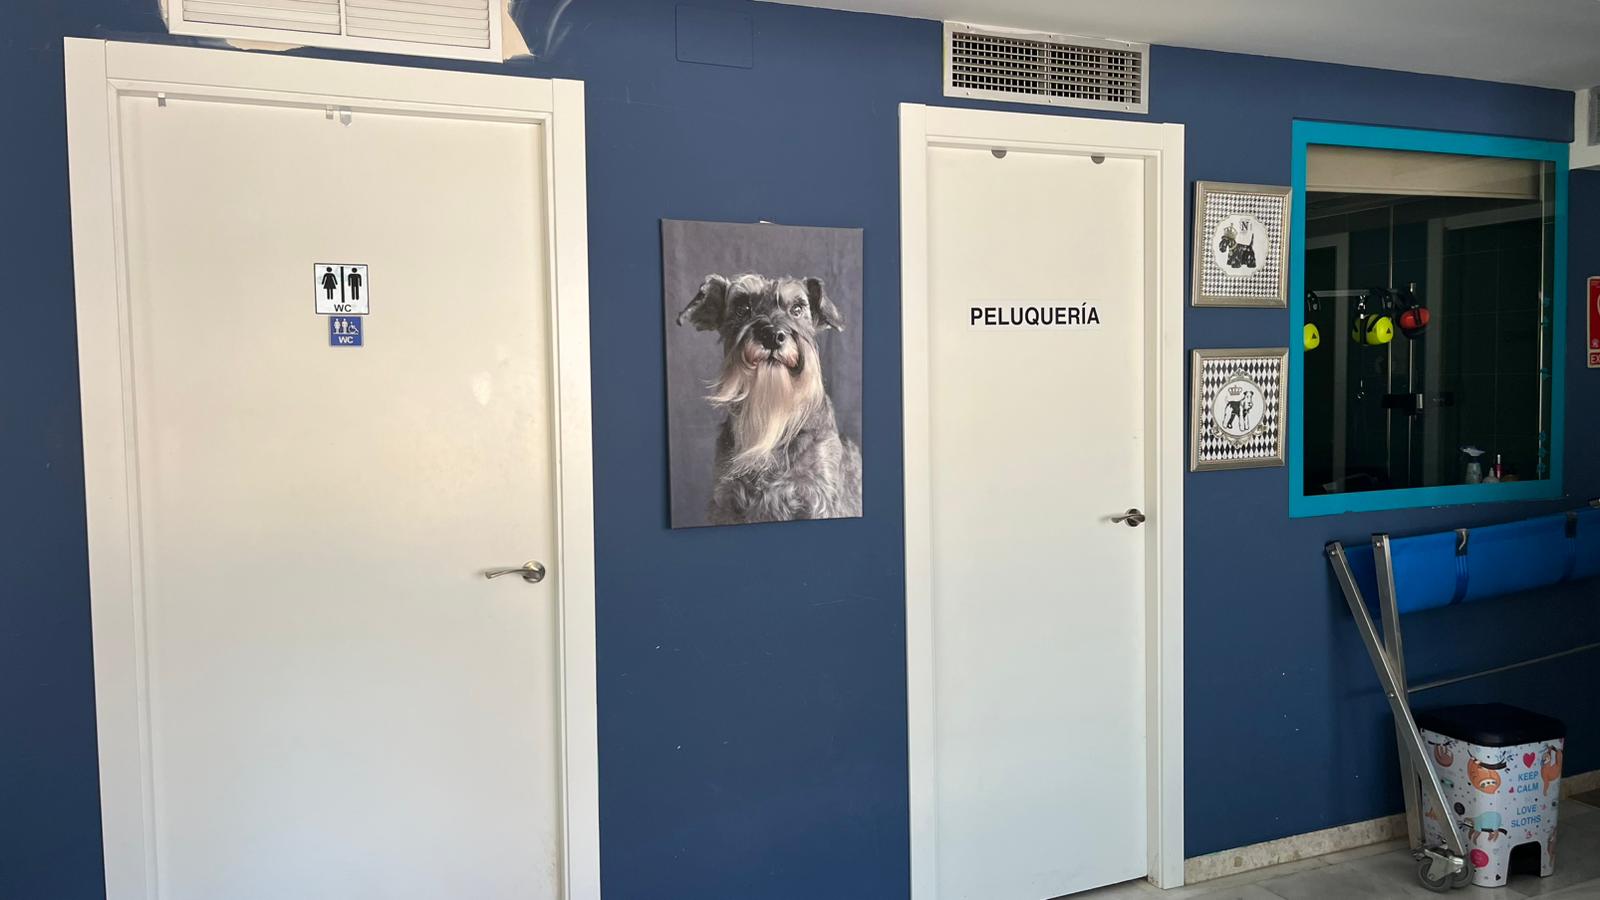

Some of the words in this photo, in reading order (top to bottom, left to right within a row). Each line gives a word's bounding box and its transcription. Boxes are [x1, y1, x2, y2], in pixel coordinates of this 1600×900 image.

[334, 304, 352, 312] WC
[970, 302, 1100, 326] PELUQUERÍA
[338, 336, 354, 344] WC
[1518, 770, 1539, 781] KEEP
[1517, 782, 1539, 793] CALM
[1516, 804, 1537, 815] LOVE
[1511, 815, 1541, 828] SLOTHS
